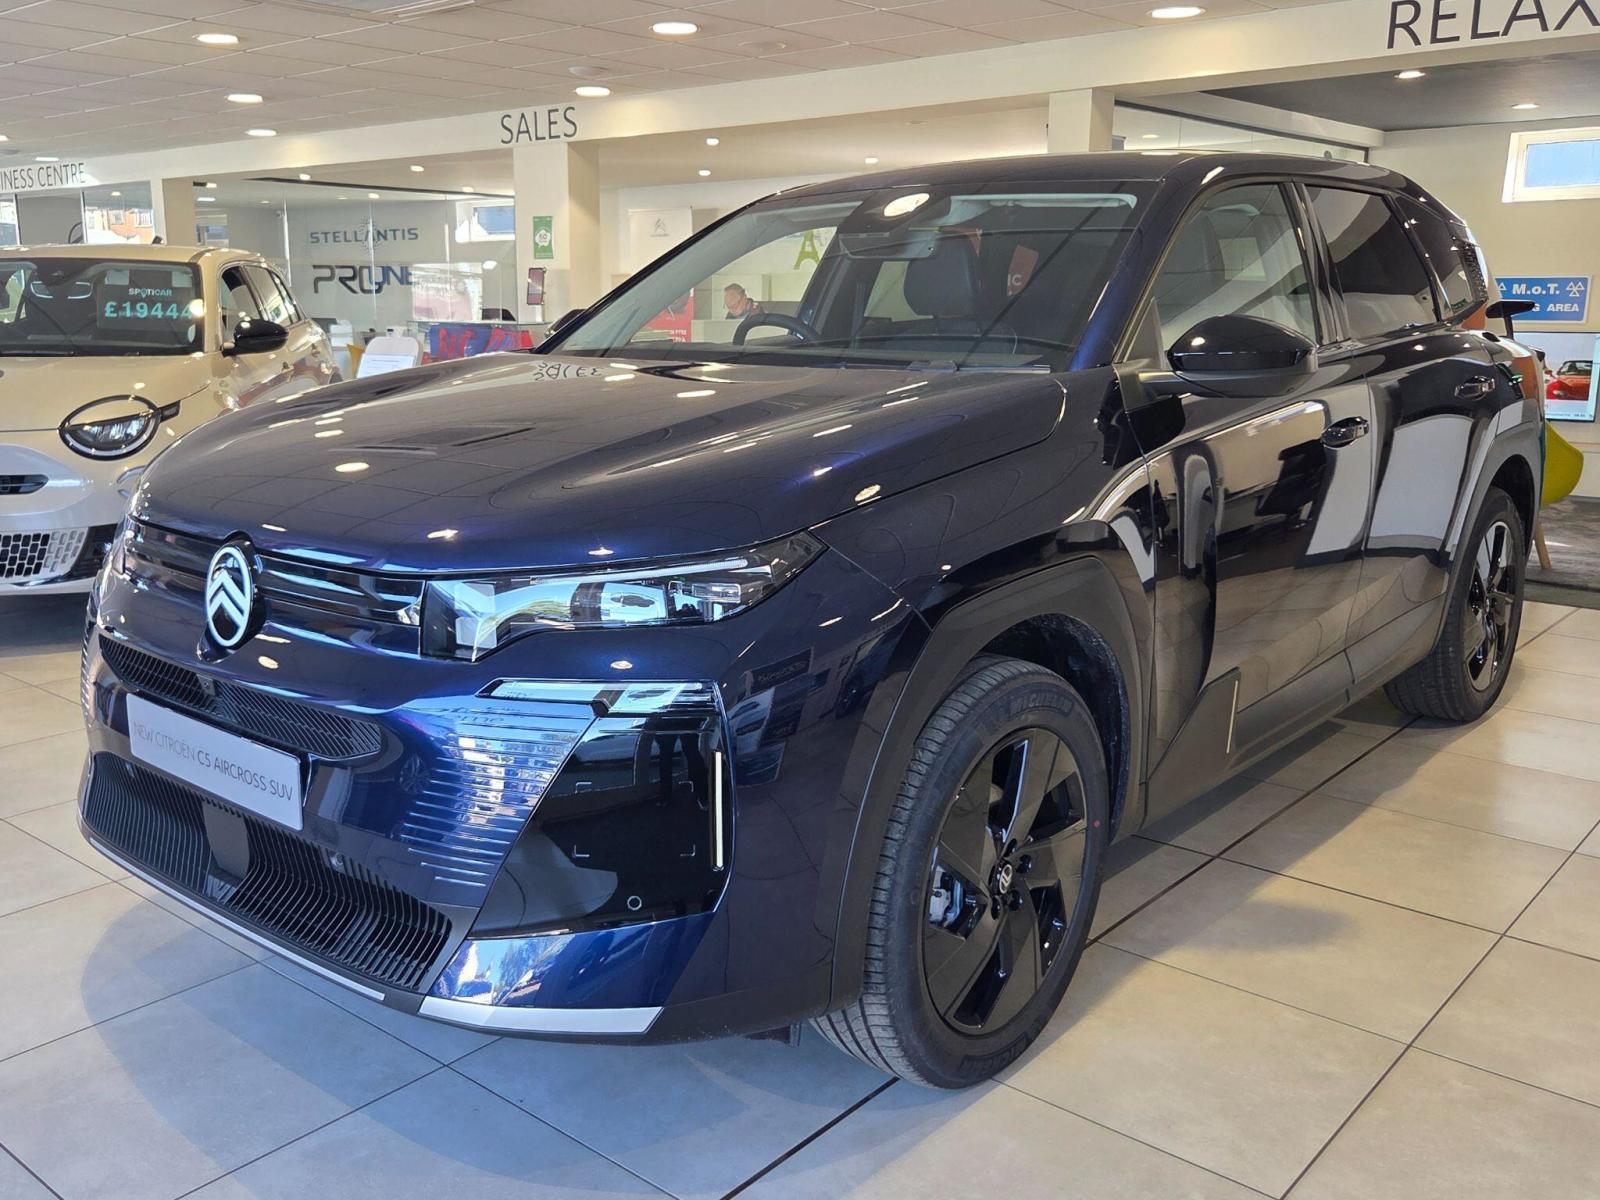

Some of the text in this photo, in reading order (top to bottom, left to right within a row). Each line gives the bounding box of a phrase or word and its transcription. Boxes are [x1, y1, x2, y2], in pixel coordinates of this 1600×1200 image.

[500, 106, 577, 144] SALES
[37, 162, 86, 187] CENTRE
[310, 227, 418, 244] STELLANTIS
[128, 287, 172, 298] SPOTICAR
[1511, 283, 1560, 295] M.o.T.
[1546, 303, 1580, 312] AREA
[133, 720, 153, 742] NEW
[197, 750, 211, 768] C5
[214, 757, 267, 792] AIRCROSS
[269, 779, 293, 801] SUV
